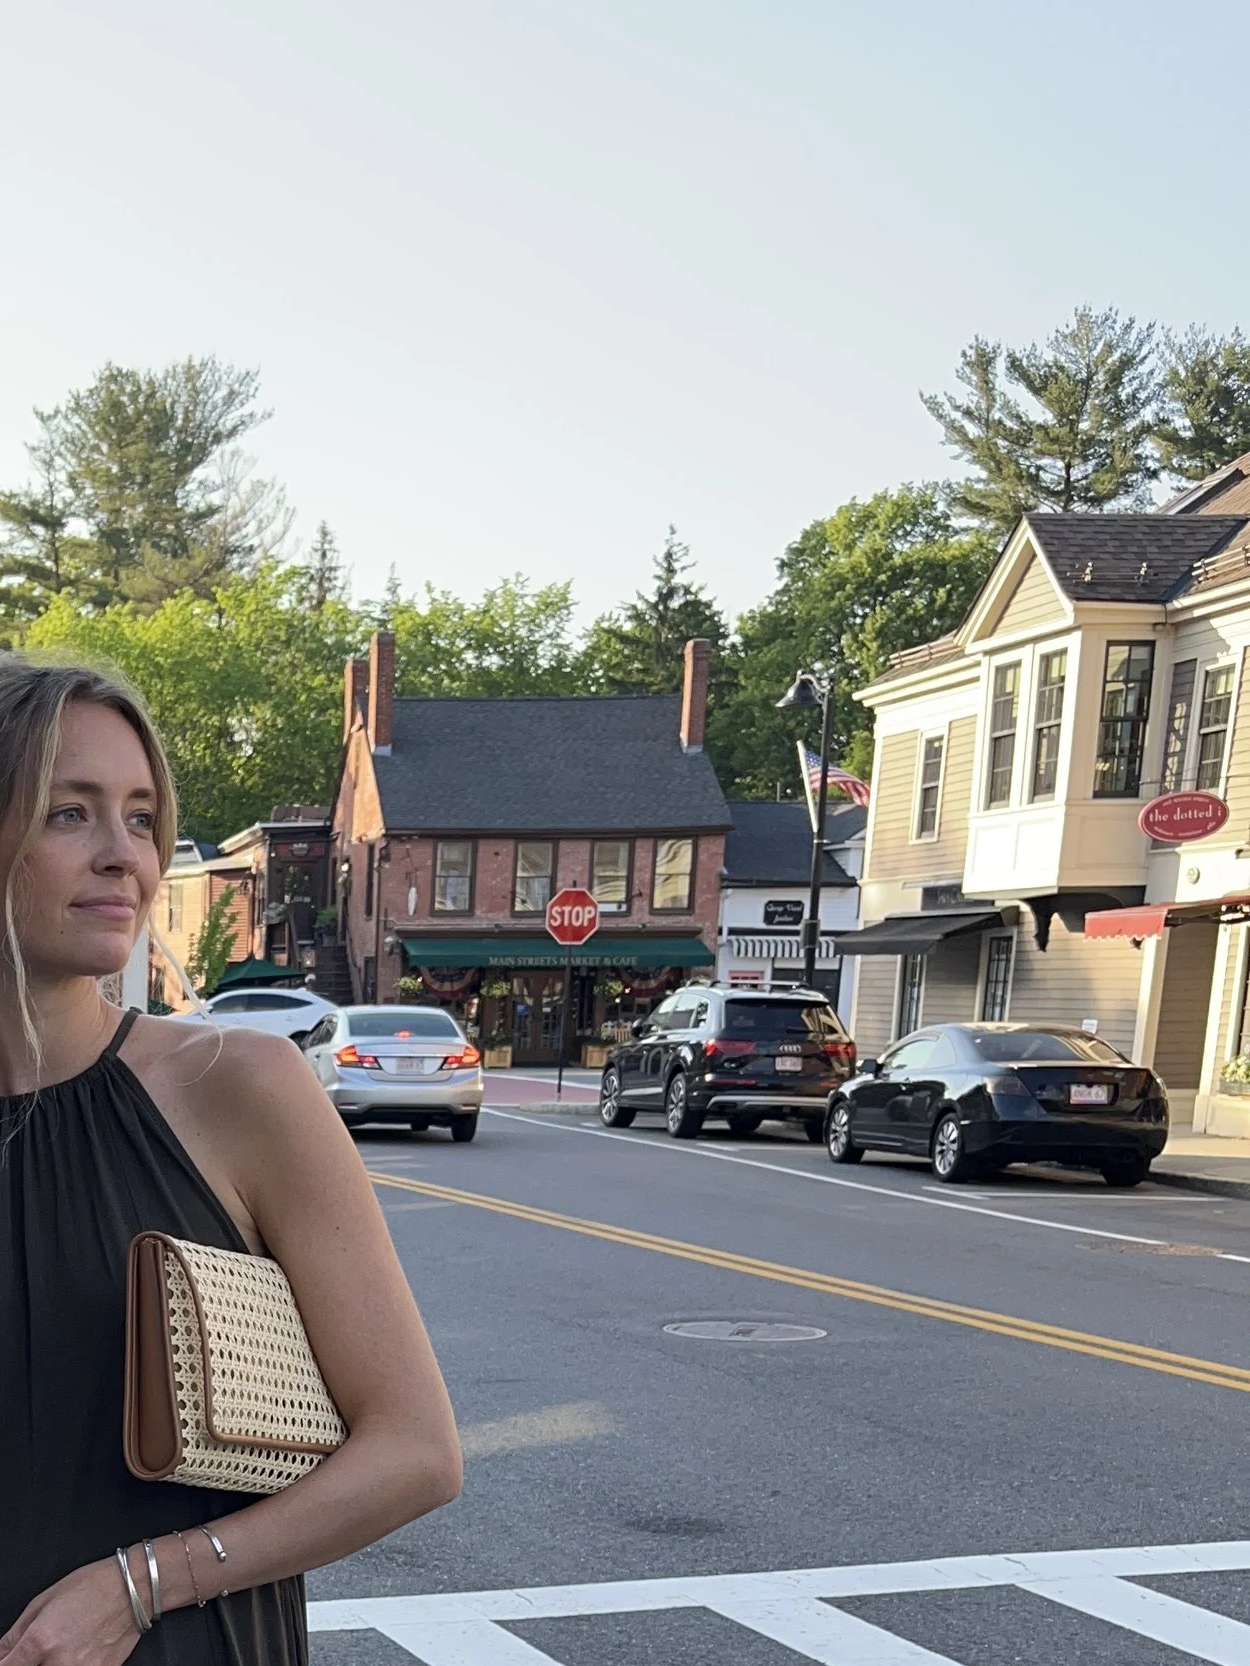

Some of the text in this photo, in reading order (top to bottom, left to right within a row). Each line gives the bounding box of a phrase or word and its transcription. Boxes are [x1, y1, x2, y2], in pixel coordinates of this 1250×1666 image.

[1149, 804, 1222, 822] the dotted i
[550, 905, 595, 927] STOP
[489, 956, 515, 966] MAIN
[516, 956, 558, 967] STREETS
